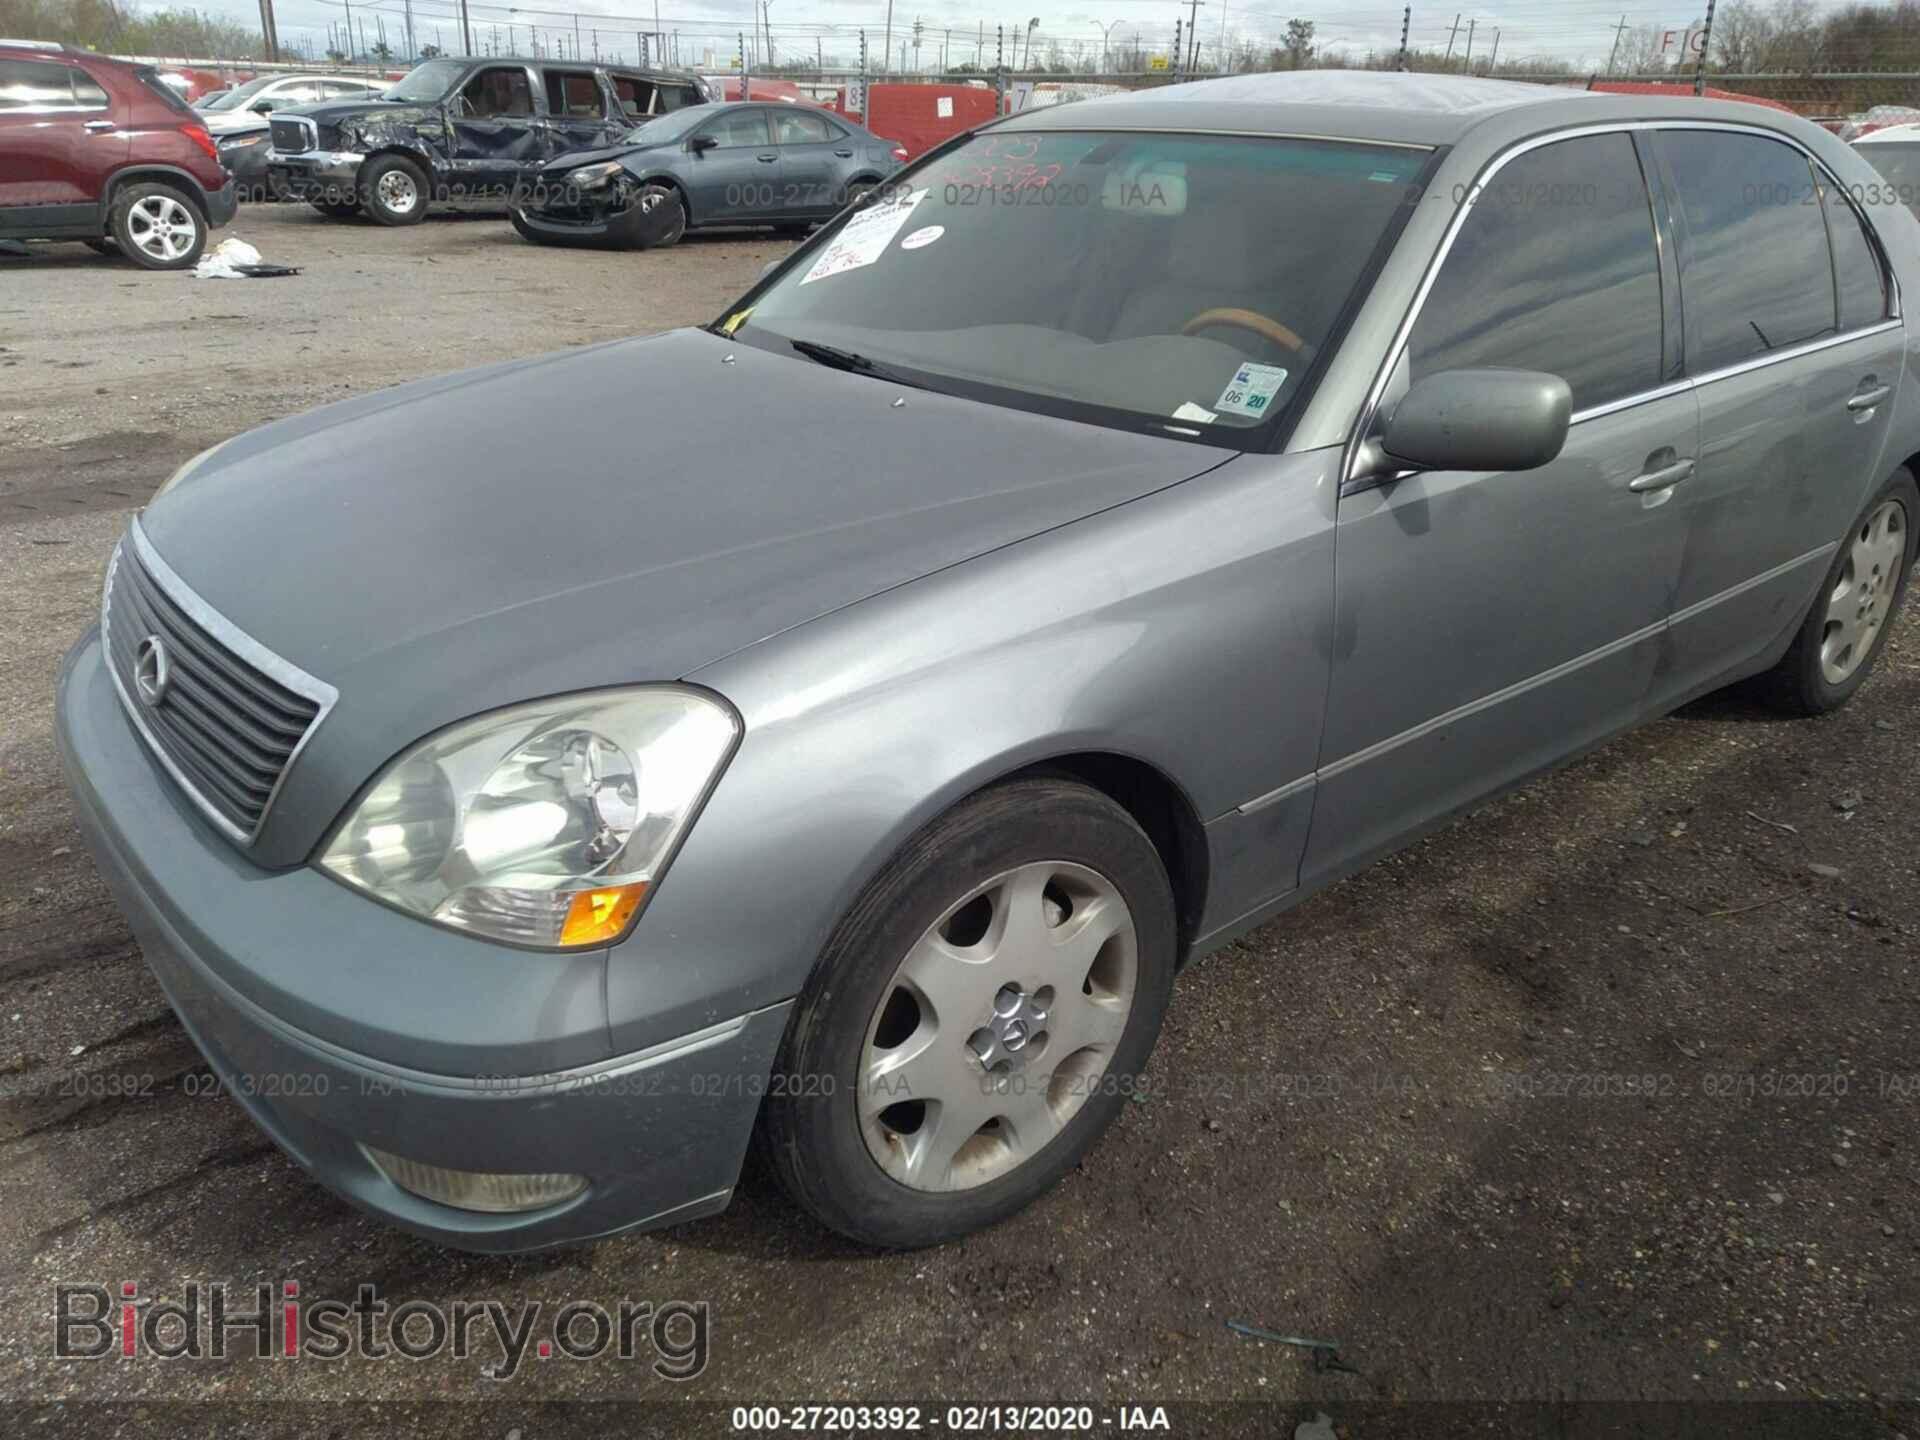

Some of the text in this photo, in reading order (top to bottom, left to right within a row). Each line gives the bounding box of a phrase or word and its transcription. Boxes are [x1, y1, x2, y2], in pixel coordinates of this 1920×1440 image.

[1662, 30, 1676, 53] F
[1017, 89, 1027, 109] 7
[1225, 390, 1267, 409] 06 20
